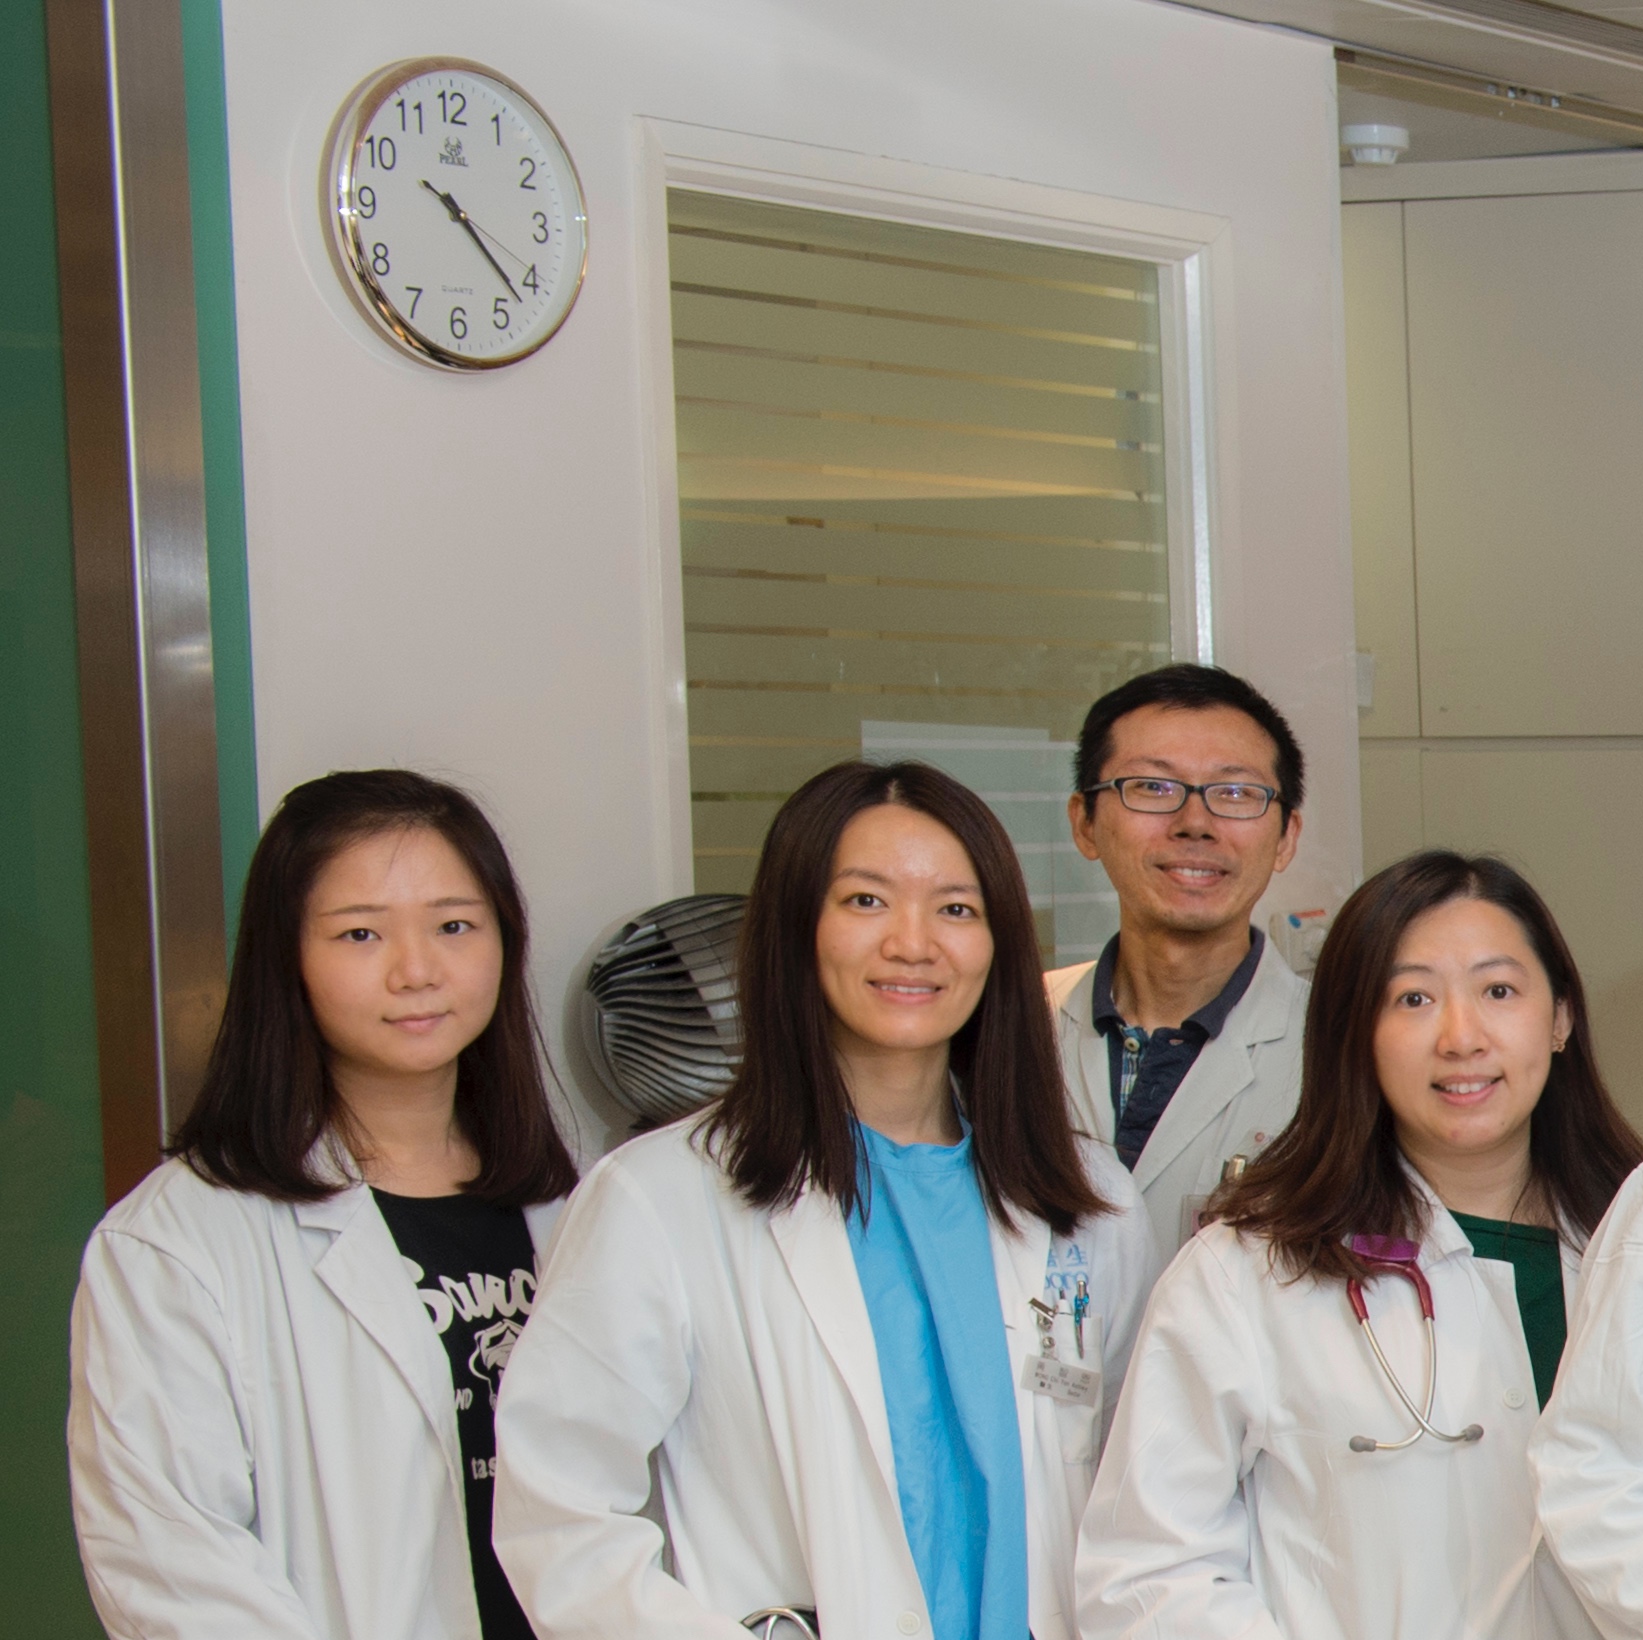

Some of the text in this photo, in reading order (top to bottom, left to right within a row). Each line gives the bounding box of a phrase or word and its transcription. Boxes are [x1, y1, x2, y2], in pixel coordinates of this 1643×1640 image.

[396, 99, 424, 135] 11
[437, 89, 468, 126] 12
[491, 113, 504, 146] 1
[364, 135, 396, 170] 10
[439, 152, 469, 167] PEARL
[519, 157, 537, 191] 2
[358, 186, 377, 219] 9
[532, 211, 549, 244] 3
[372, 242, 391, 276] 8
[441, 284, 474, 296] QUARTZ
[522, 264, 541, 296] 4
[405, 286, 424, 320] 7
[493, 297, 510, 330] 5
[449, 306, 468, 340] 6
